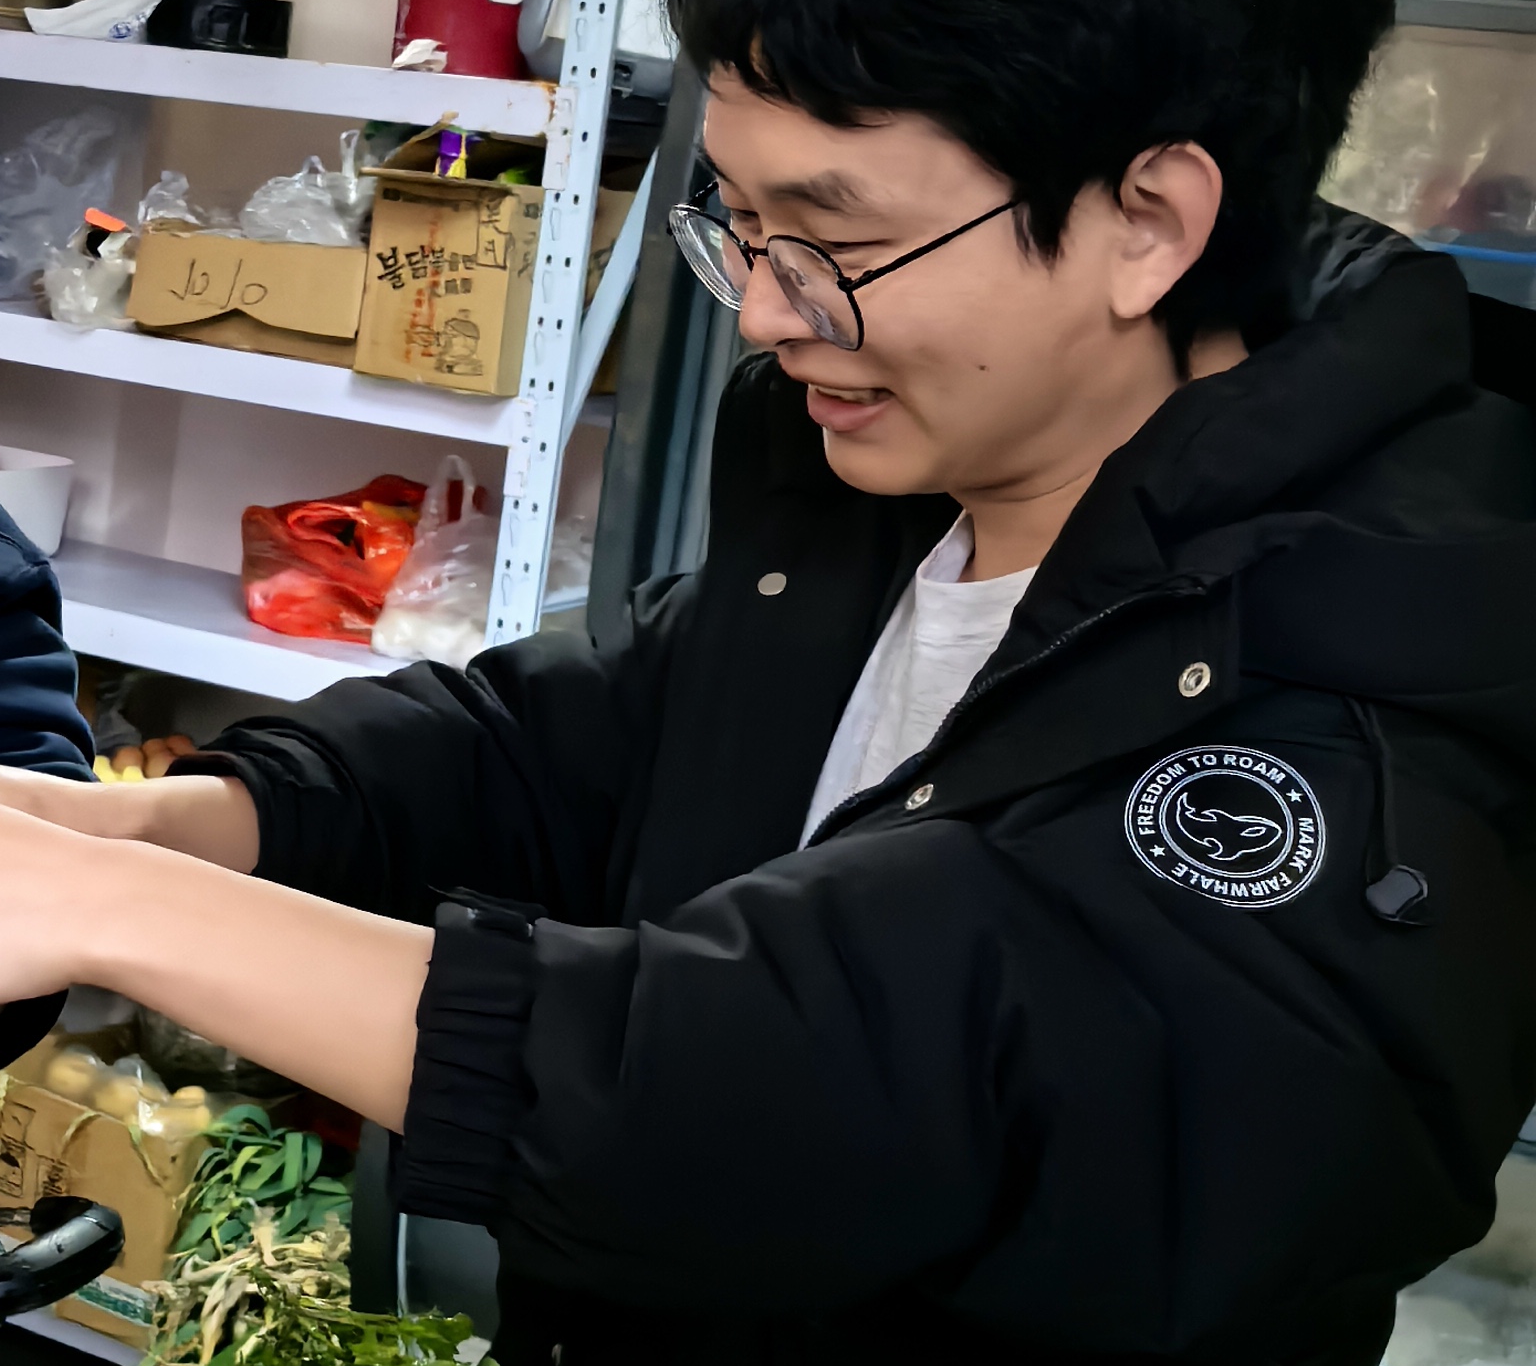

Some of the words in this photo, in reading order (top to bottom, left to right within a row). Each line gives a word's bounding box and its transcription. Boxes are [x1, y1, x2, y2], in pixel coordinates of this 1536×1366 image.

[1137, 762, 1188, 836] FREEDOM
[1187, 754, 1217, 768] TO
[1223, 753, 1287, 785] ROAM
[1289, 816, 1314, 874] MARK
[1170, 862, 1293, 898] FAIRWHALE
